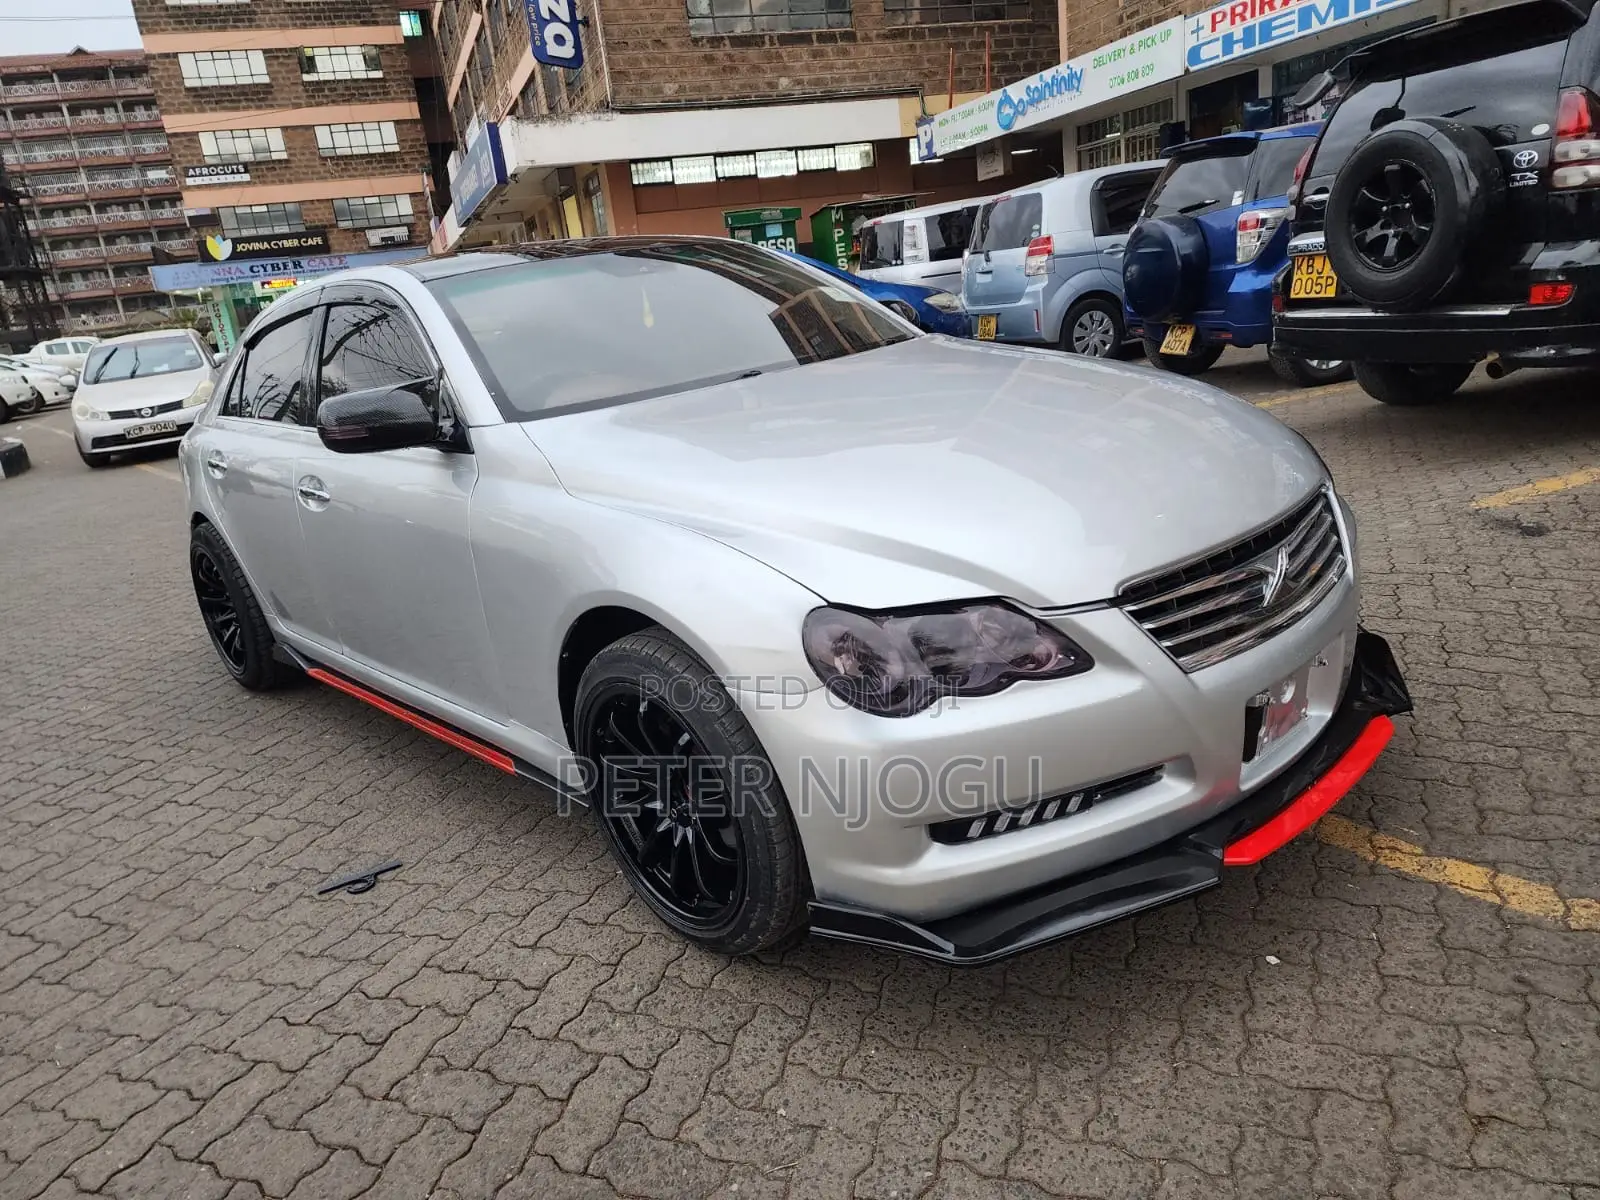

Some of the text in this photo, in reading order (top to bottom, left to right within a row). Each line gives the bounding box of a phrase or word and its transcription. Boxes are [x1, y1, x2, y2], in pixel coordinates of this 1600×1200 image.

[1093, 28, 1172, 69] DELIVERY & PICK UP
[188, 165, 244, 176] AFROCUTS
[236, 236, 323, 252] JOVINA CYBER CAFE
[1297, 242, 1325, 251] PRADO
[249, 260, 304, 274] CYBER
[307, 255, 347, 268] CAFE
[1296, 256, 1326, 275] KBJ
[126, 422, 175, 437] KCP 904U
